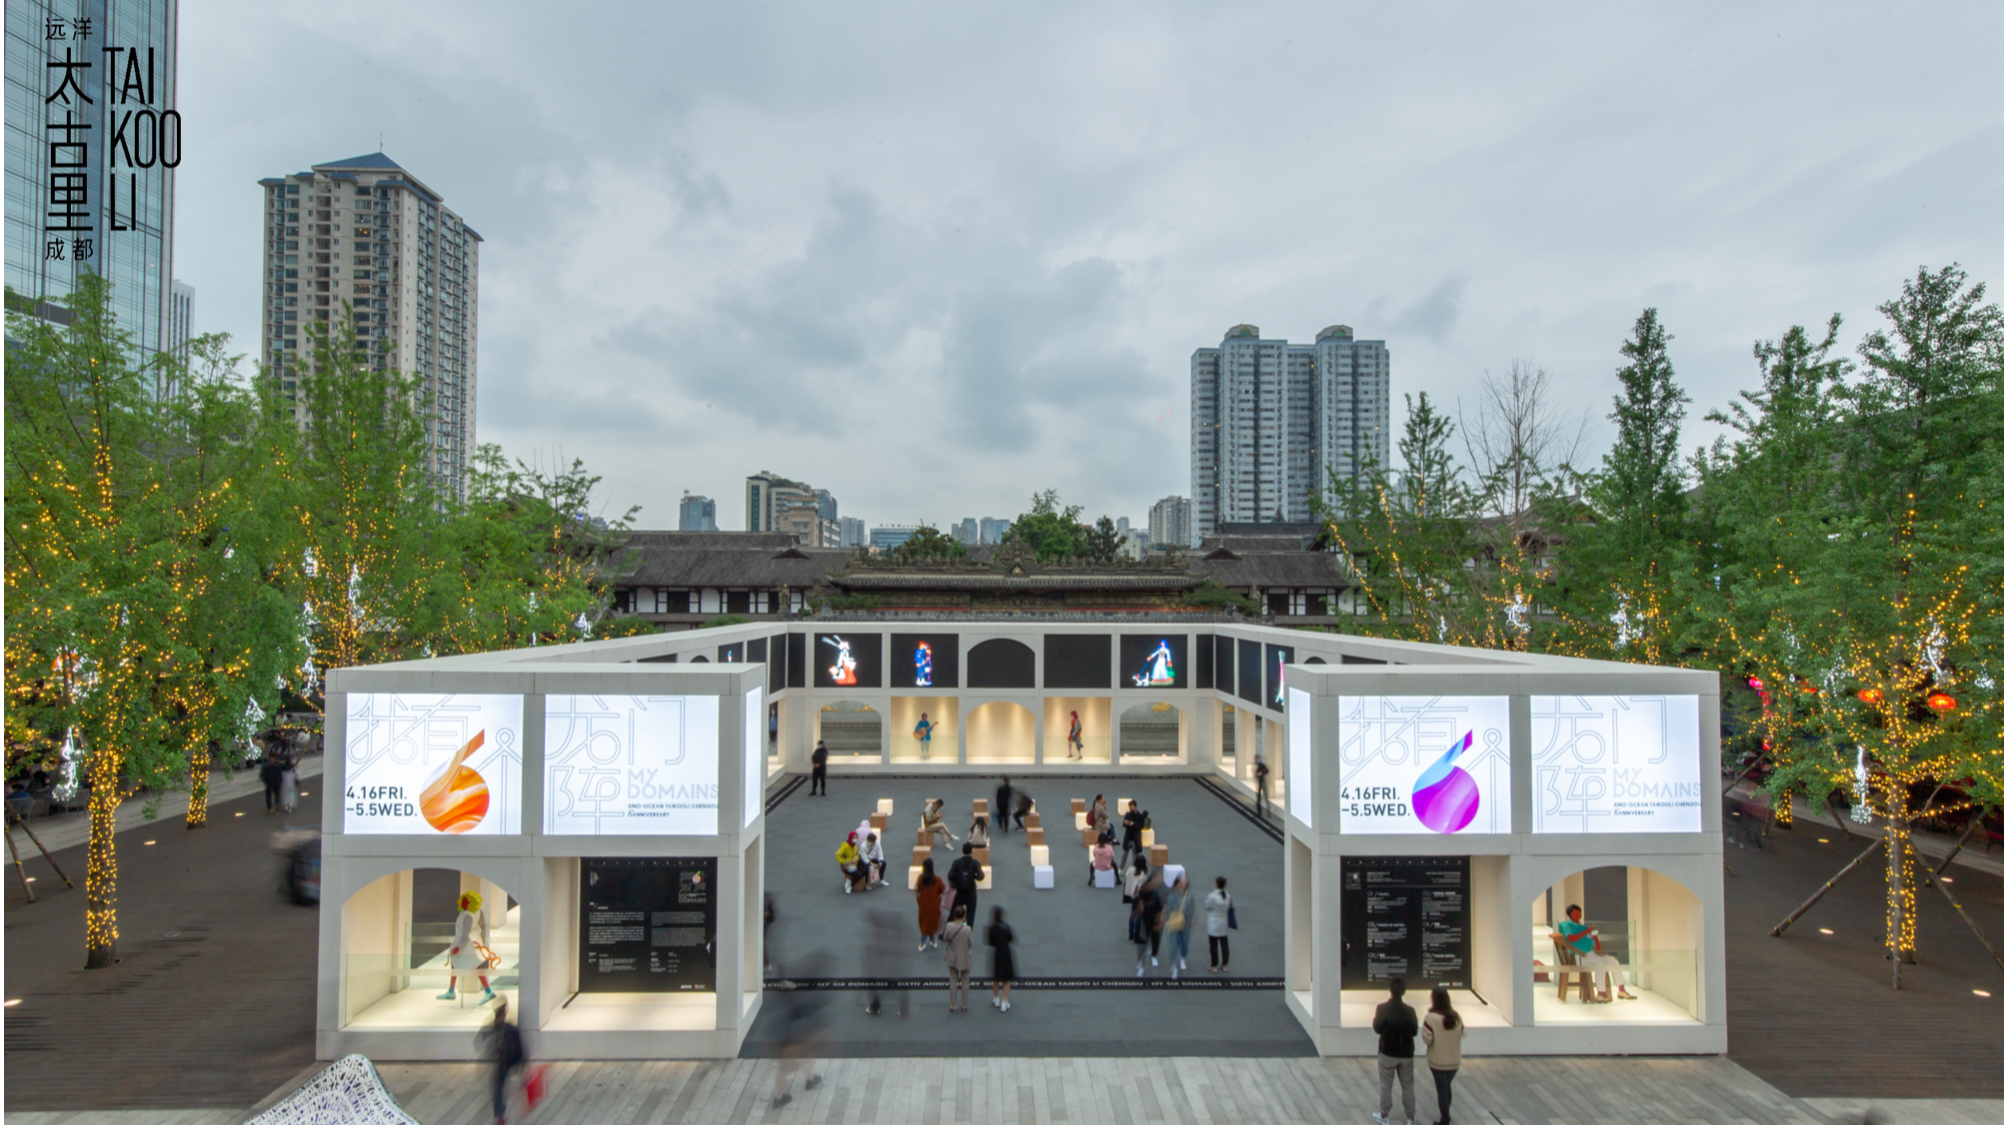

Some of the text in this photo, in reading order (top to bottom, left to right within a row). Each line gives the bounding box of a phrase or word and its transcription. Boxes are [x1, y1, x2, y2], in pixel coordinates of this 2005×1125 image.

[628, 768, 658, 784] MY
[1613, 767, 1642, 783] MY
[627, 784, 719, 799] DOMAINS
[1613, 782, 1701, 798] DOMAINS
